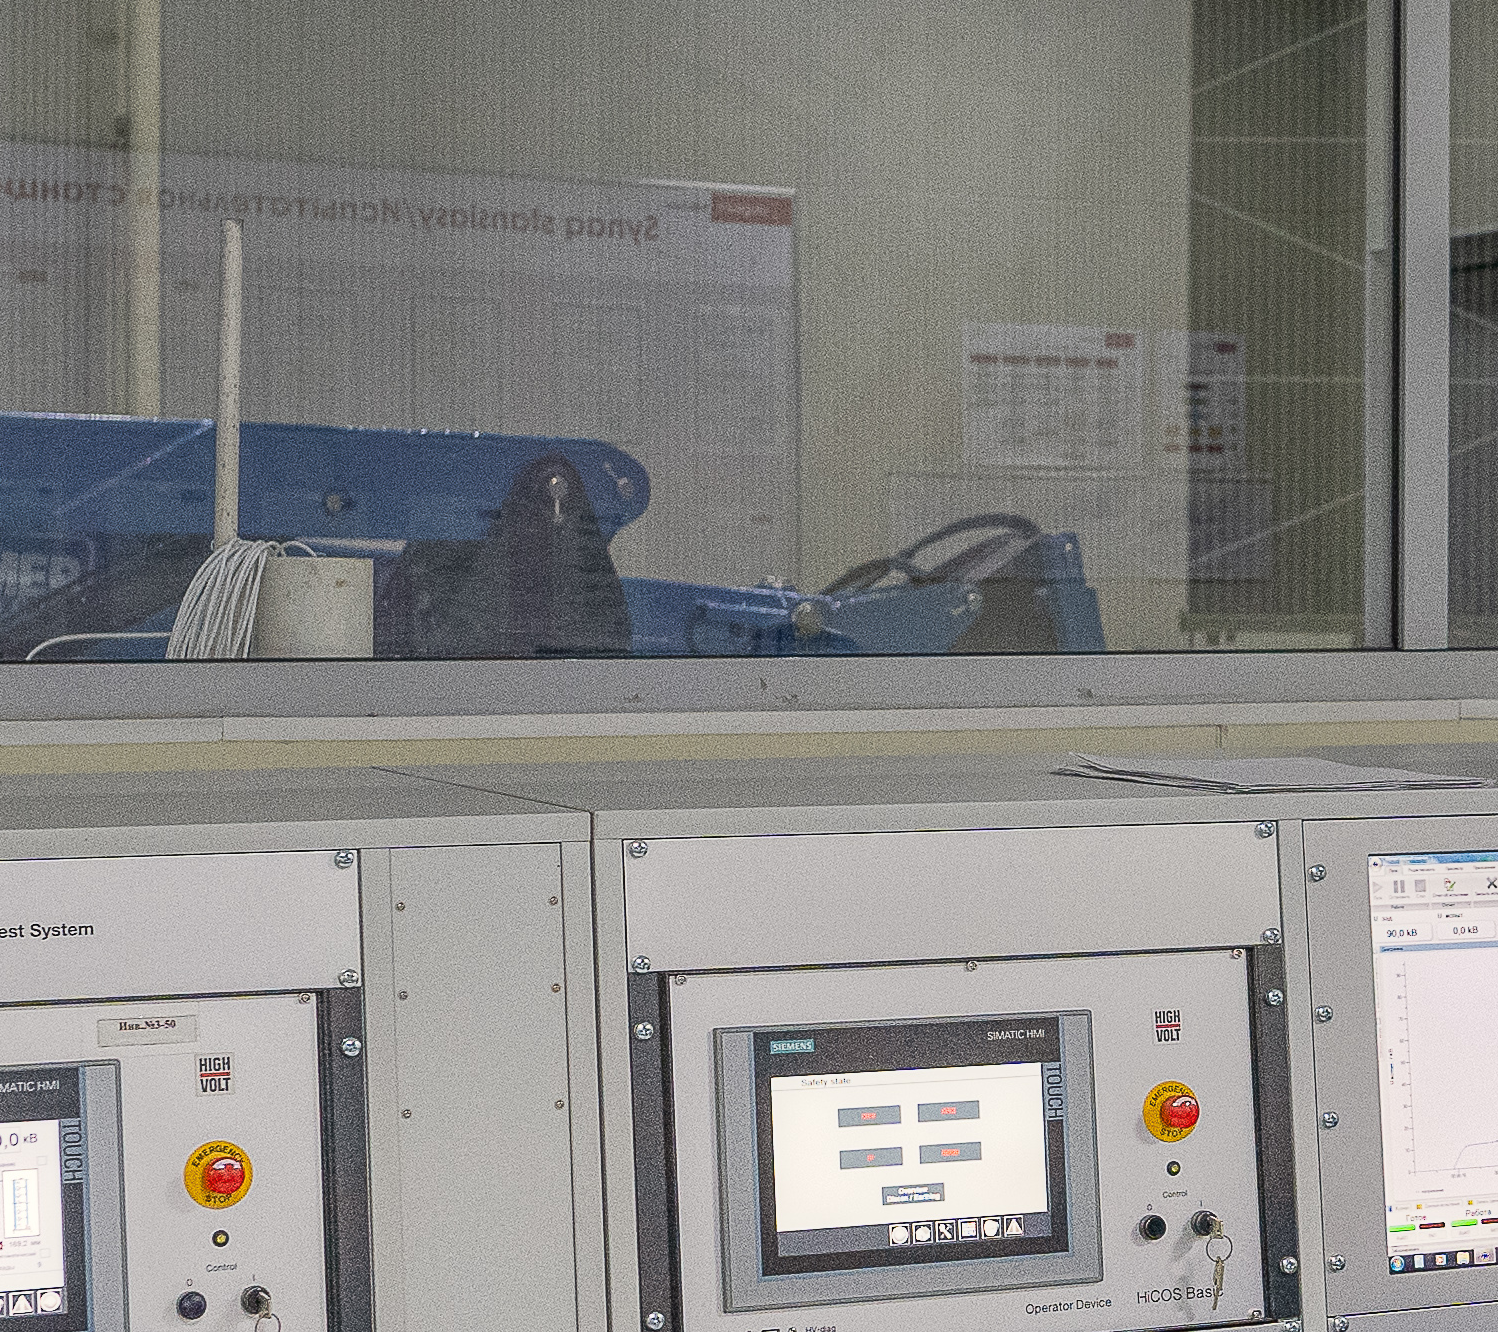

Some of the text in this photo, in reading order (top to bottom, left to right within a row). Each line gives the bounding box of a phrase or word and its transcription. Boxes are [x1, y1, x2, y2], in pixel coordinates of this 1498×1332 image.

[30, 923, 94, 940] System
[1155, 1010, 1180, 1024] HIGH
[987, 1029, 1045, 1041] SIMATIC HMI
[1156, 1028, 1181, 1042] VOLT
[772, 1040, 812, 1052] SIEMENS
[199, 1057, 231, 1072] HIGH
[37, 1080, 60, 1091] HMI
[200, 1077, 231, 1092] VOLT
[1046, 1064, 1063, 1120] TOUCH
[23, 1134, 38, 1144] кВ
[1161, 1128, 1183, 1138] STOP
[63, 1121, 81, 1183] TOUCH
[205, 1193, 232, 1204] STOP
[1162, 1190, 1187, 1199] Control
[206, 1263, 237, 1272] Control
[1137, 1287, 1182, 1303] HiCOS
[1025, 1296, 1112, 1315] Operator Device
